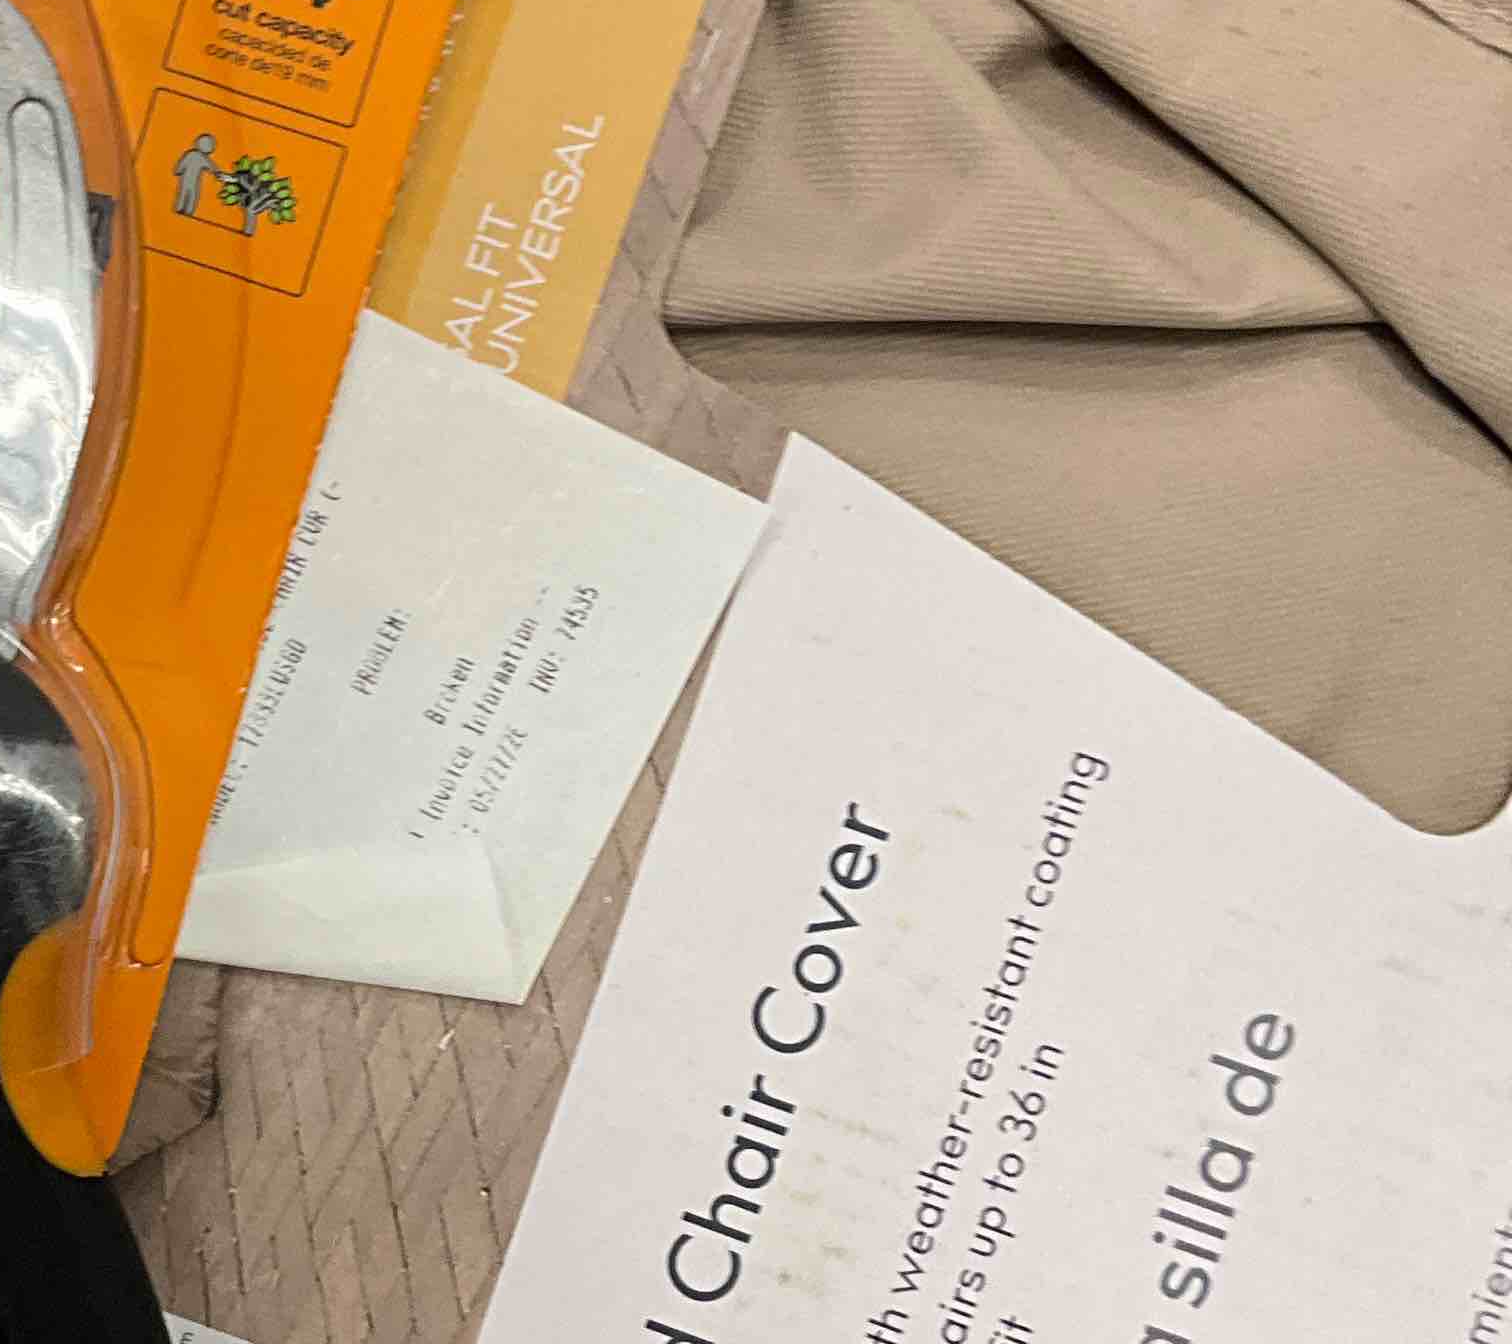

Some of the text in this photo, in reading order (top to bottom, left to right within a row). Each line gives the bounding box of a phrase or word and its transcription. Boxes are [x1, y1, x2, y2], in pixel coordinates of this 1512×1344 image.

[212, 0, 355, 56] cut capacity
[445, 201, 518, 353] AL FIT
[487, 113, 606, 374] UNIVERSAL
[419, 746, 475, 821] Invoice
[460, 618, 539, 736] Information
[423, 657, 476, 726] Broken
[665, 1073, 797, 1302] Chair
[751, 801, 890, 1054] Cover
[890, 915, 1043, 1293] weather-resistant
[1025, 752, 1110, 907] coating
[1018, 1045, 1064, 1080] in
[997, 1090, 1047, 1142] 36
[1152, 1137, 1256, 1309] silla
[1208, 1014, 1295, 1117] de
[982, 1153, 1025, 1193] to
[968, 1206, 1016, 1257] up
